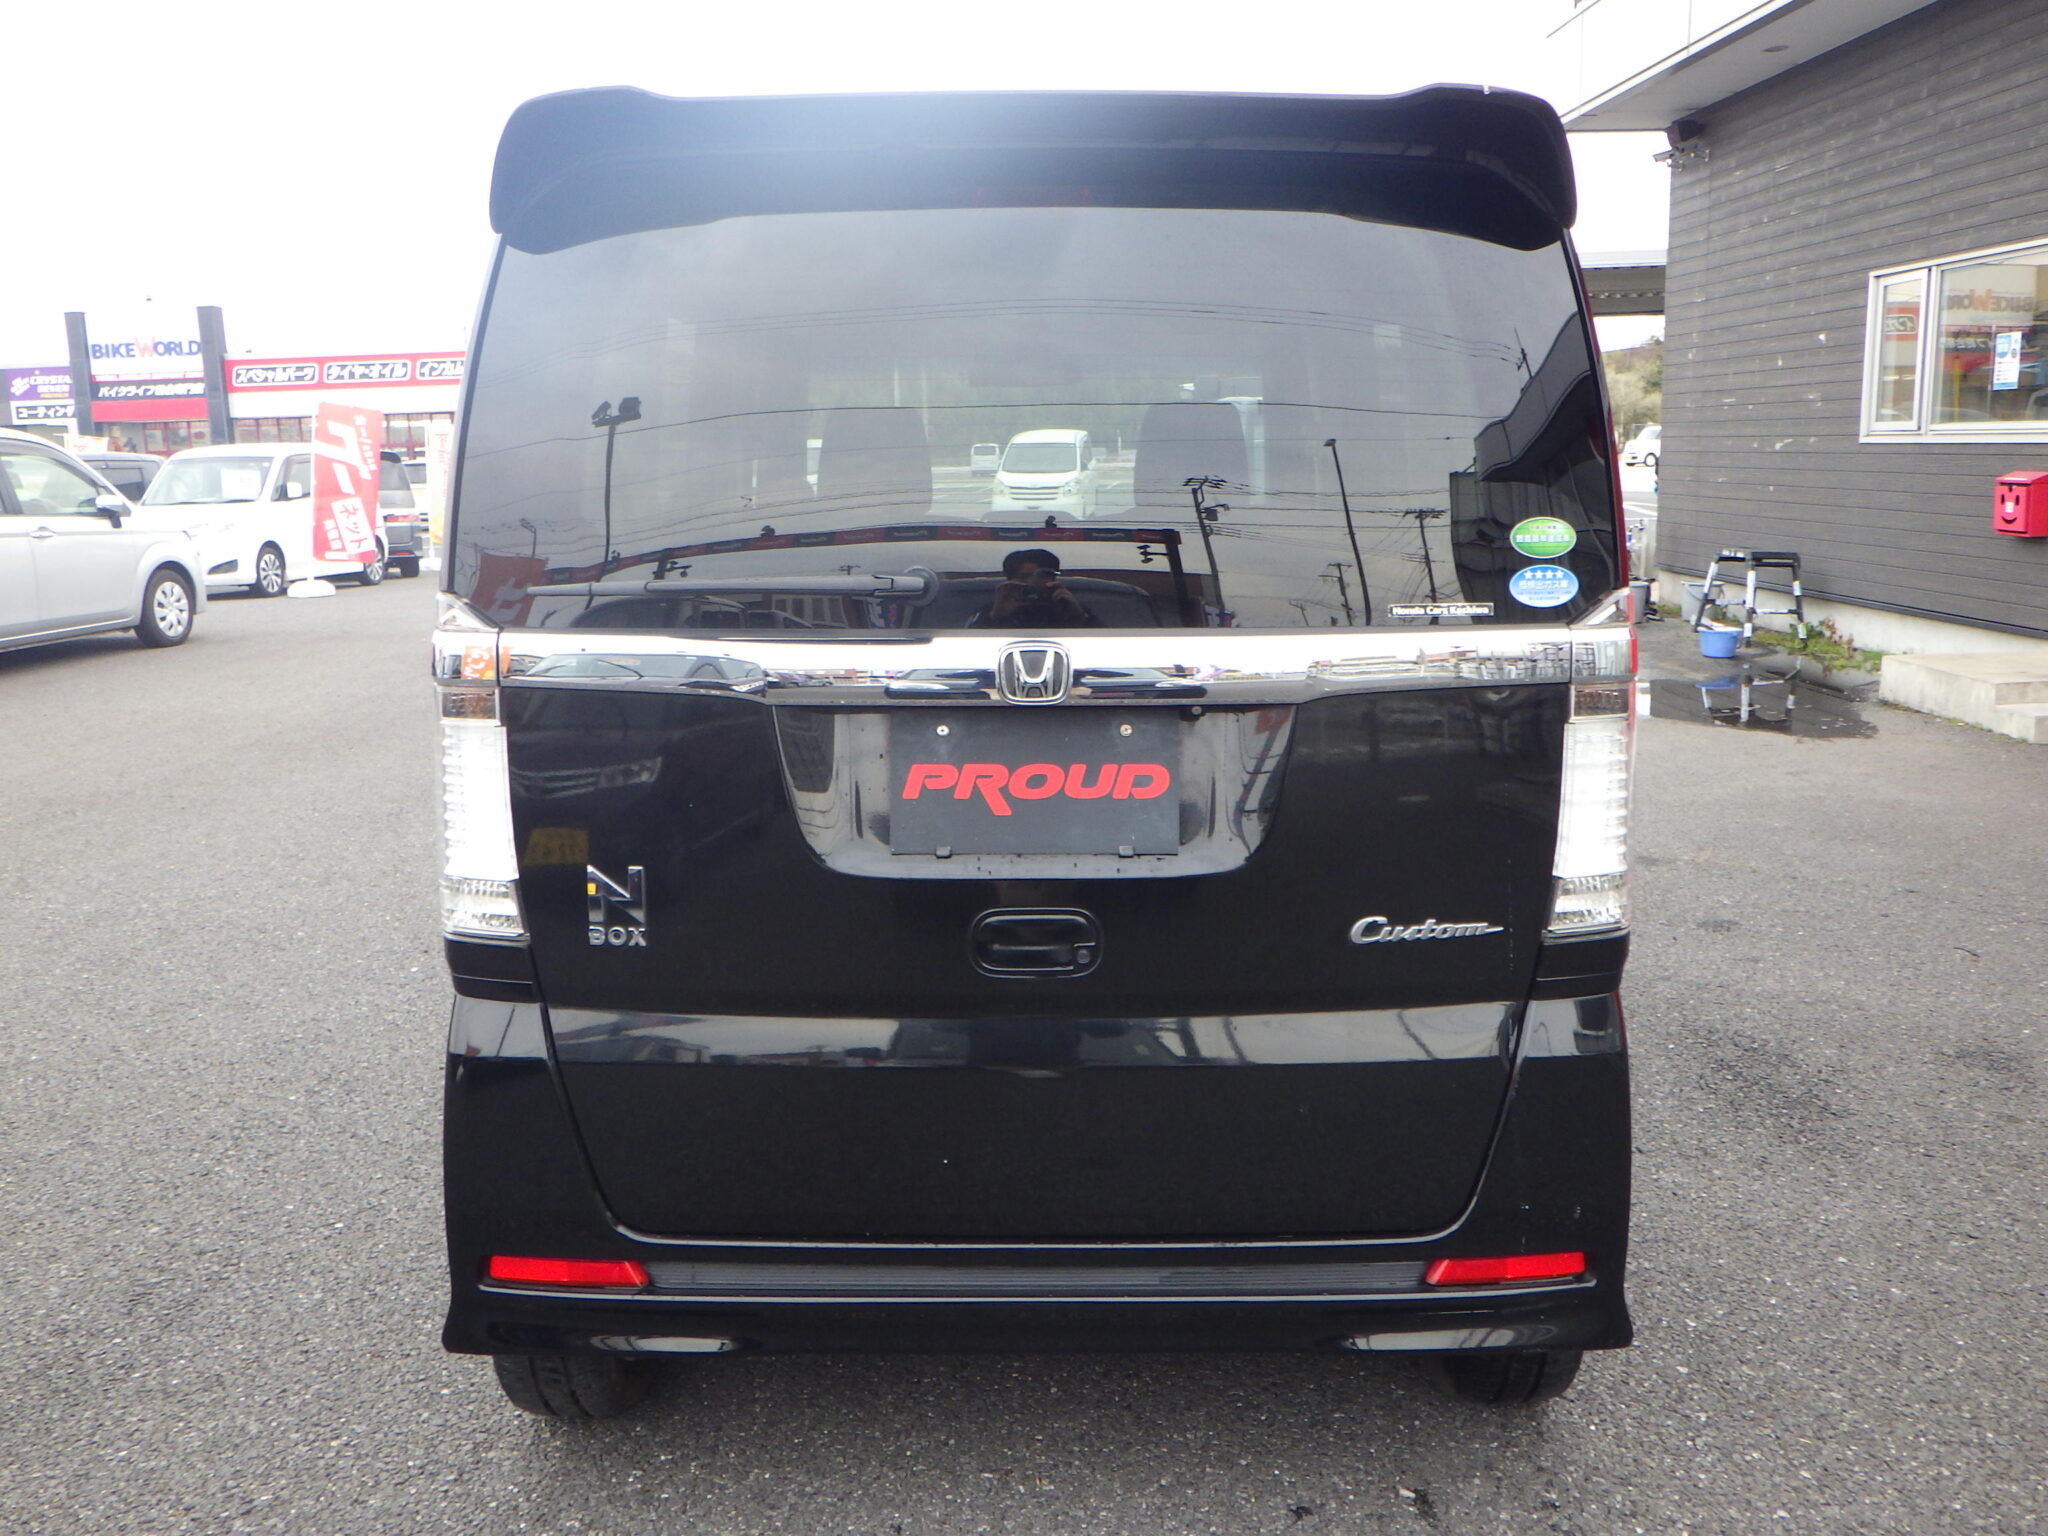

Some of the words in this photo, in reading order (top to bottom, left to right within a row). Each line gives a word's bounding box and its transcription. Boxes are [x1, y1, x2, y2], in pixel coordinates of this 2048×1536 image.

[1392, 606, 1424, 615] Honda
[1426, 606, 1448, 615] Cars
[902, 763, 1170, 816] PROUD
[587, 864, 646, 923] N
[588, 926, 647, 946] BOX
[1350, 906, 1504, 944] Custom
